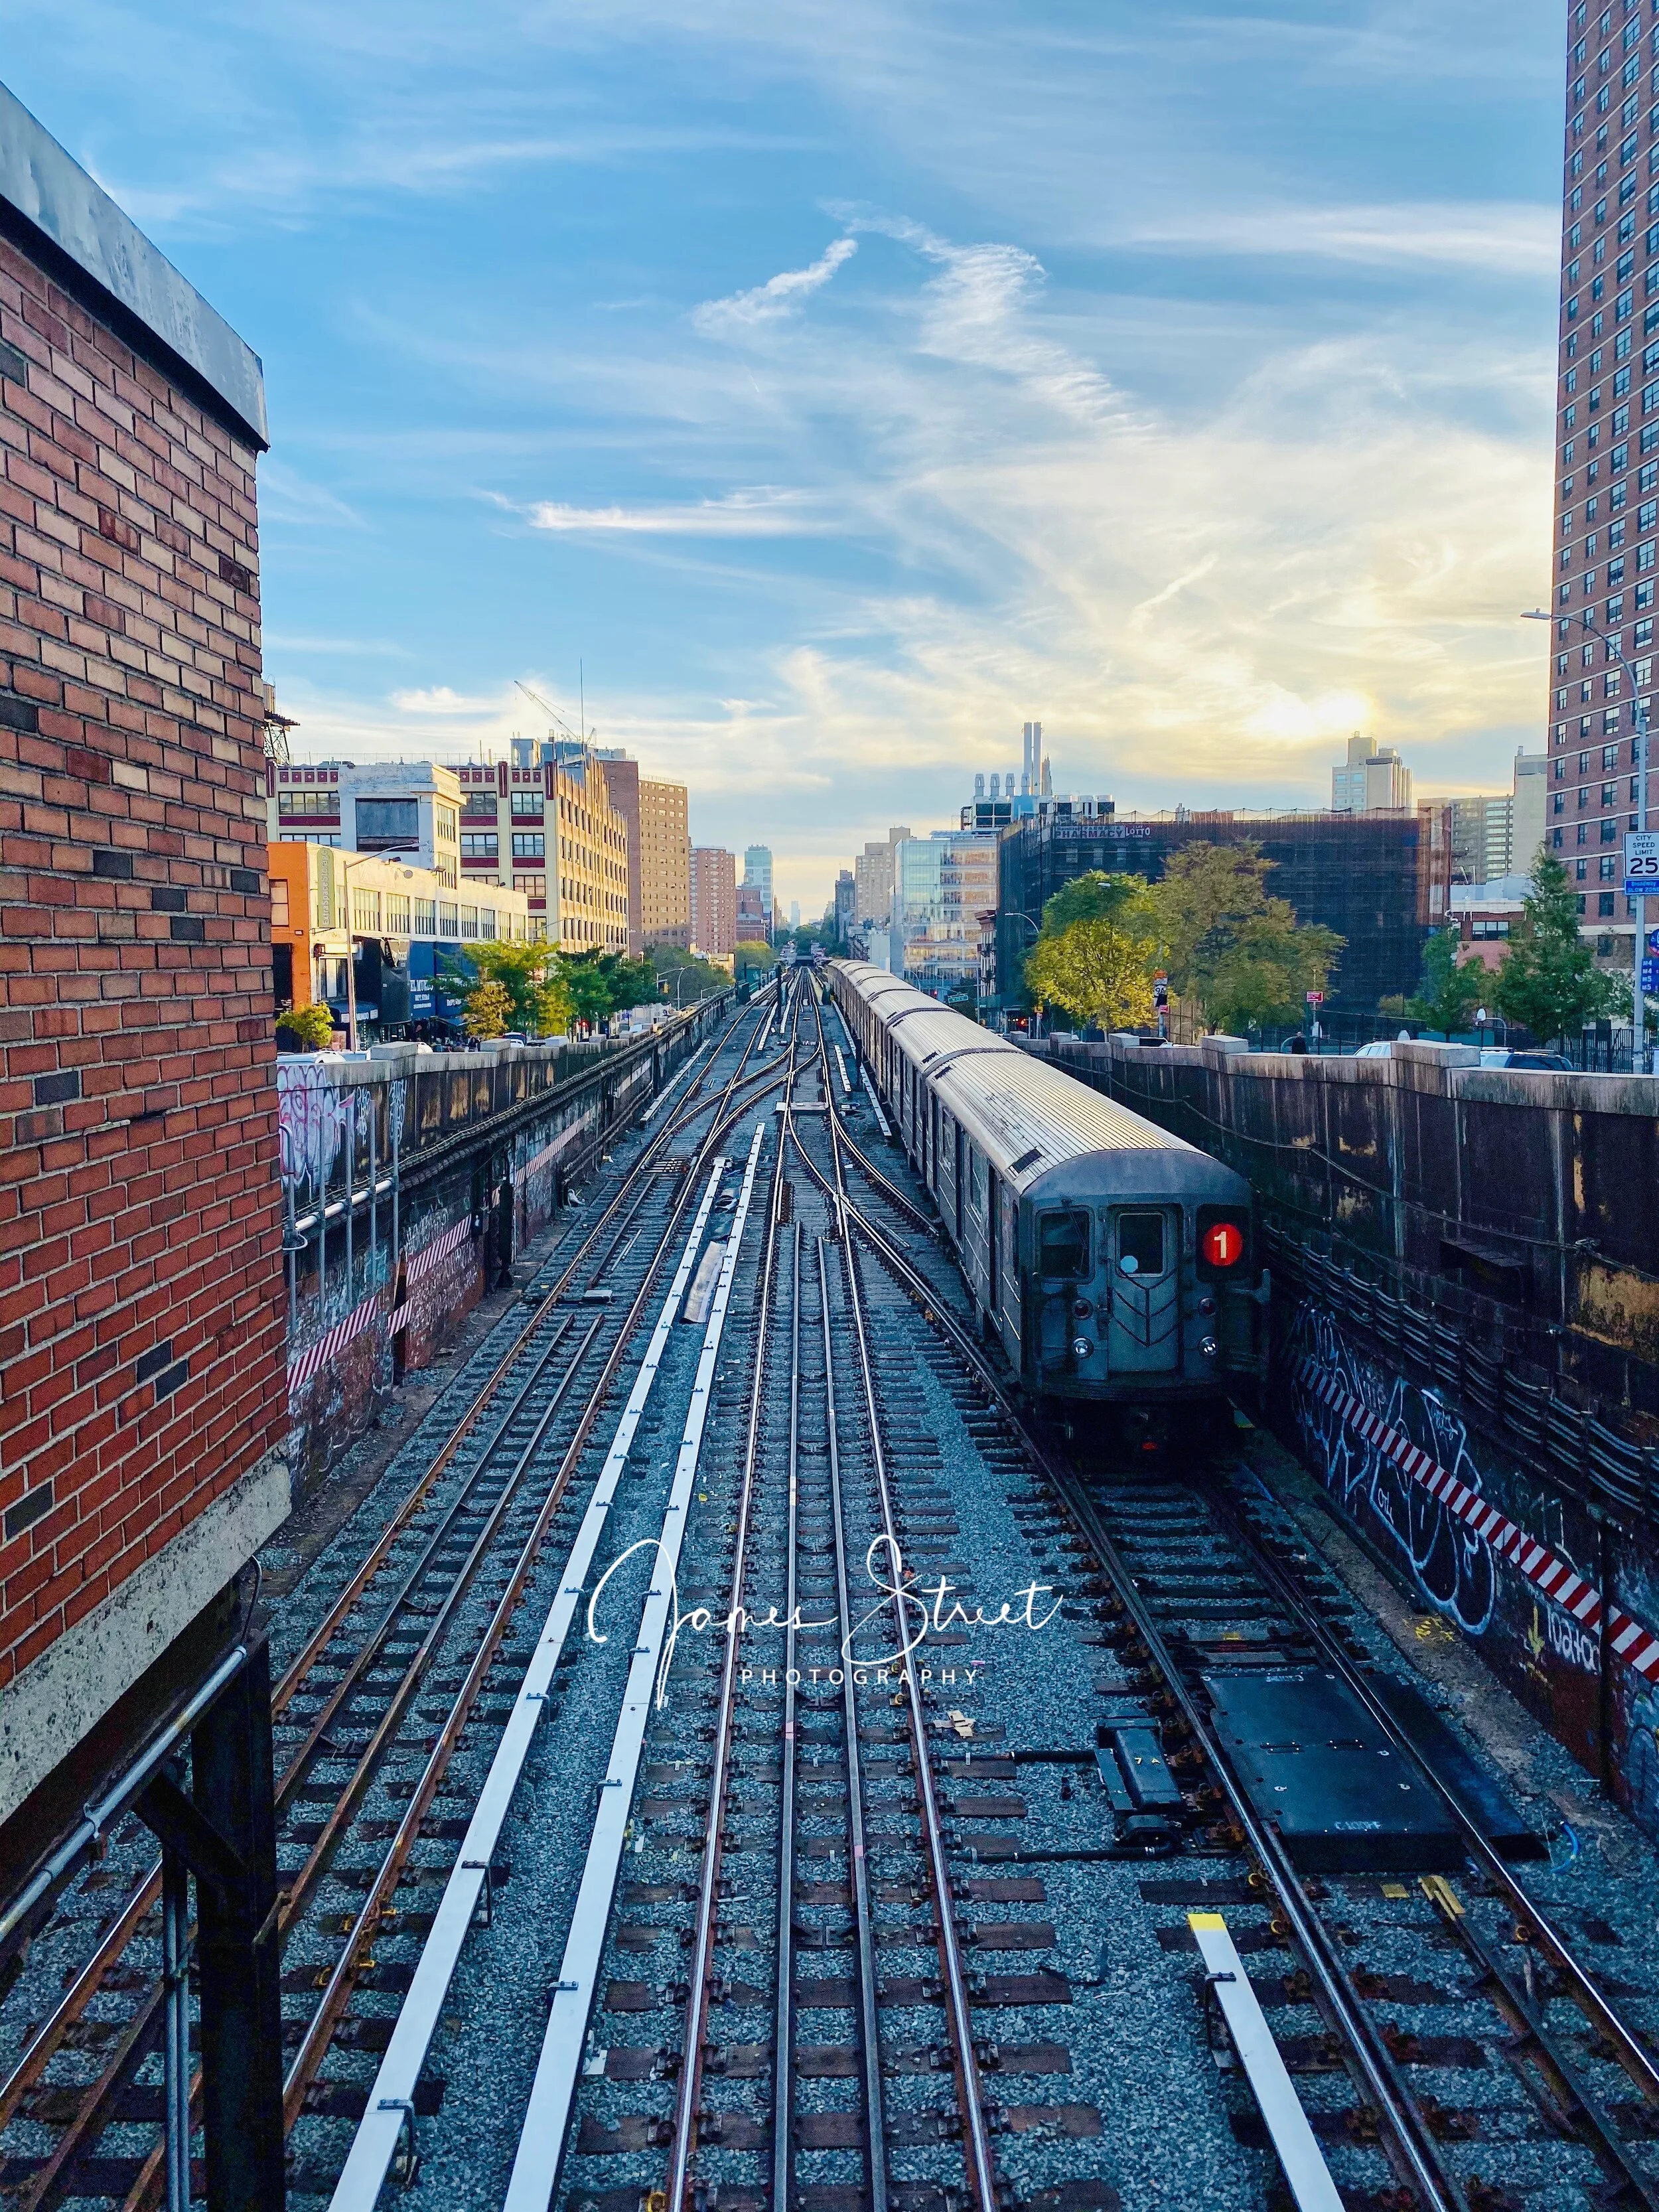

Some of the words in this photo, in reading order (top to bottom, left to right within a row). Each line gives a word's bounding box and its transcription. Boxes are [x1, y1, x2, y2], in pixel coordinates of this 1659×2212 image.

[1126, 827, 1151, 836] LOTTO
[1630, 857, 1658, 874] 25
[1214, 1231, 1227, 1258] 1
